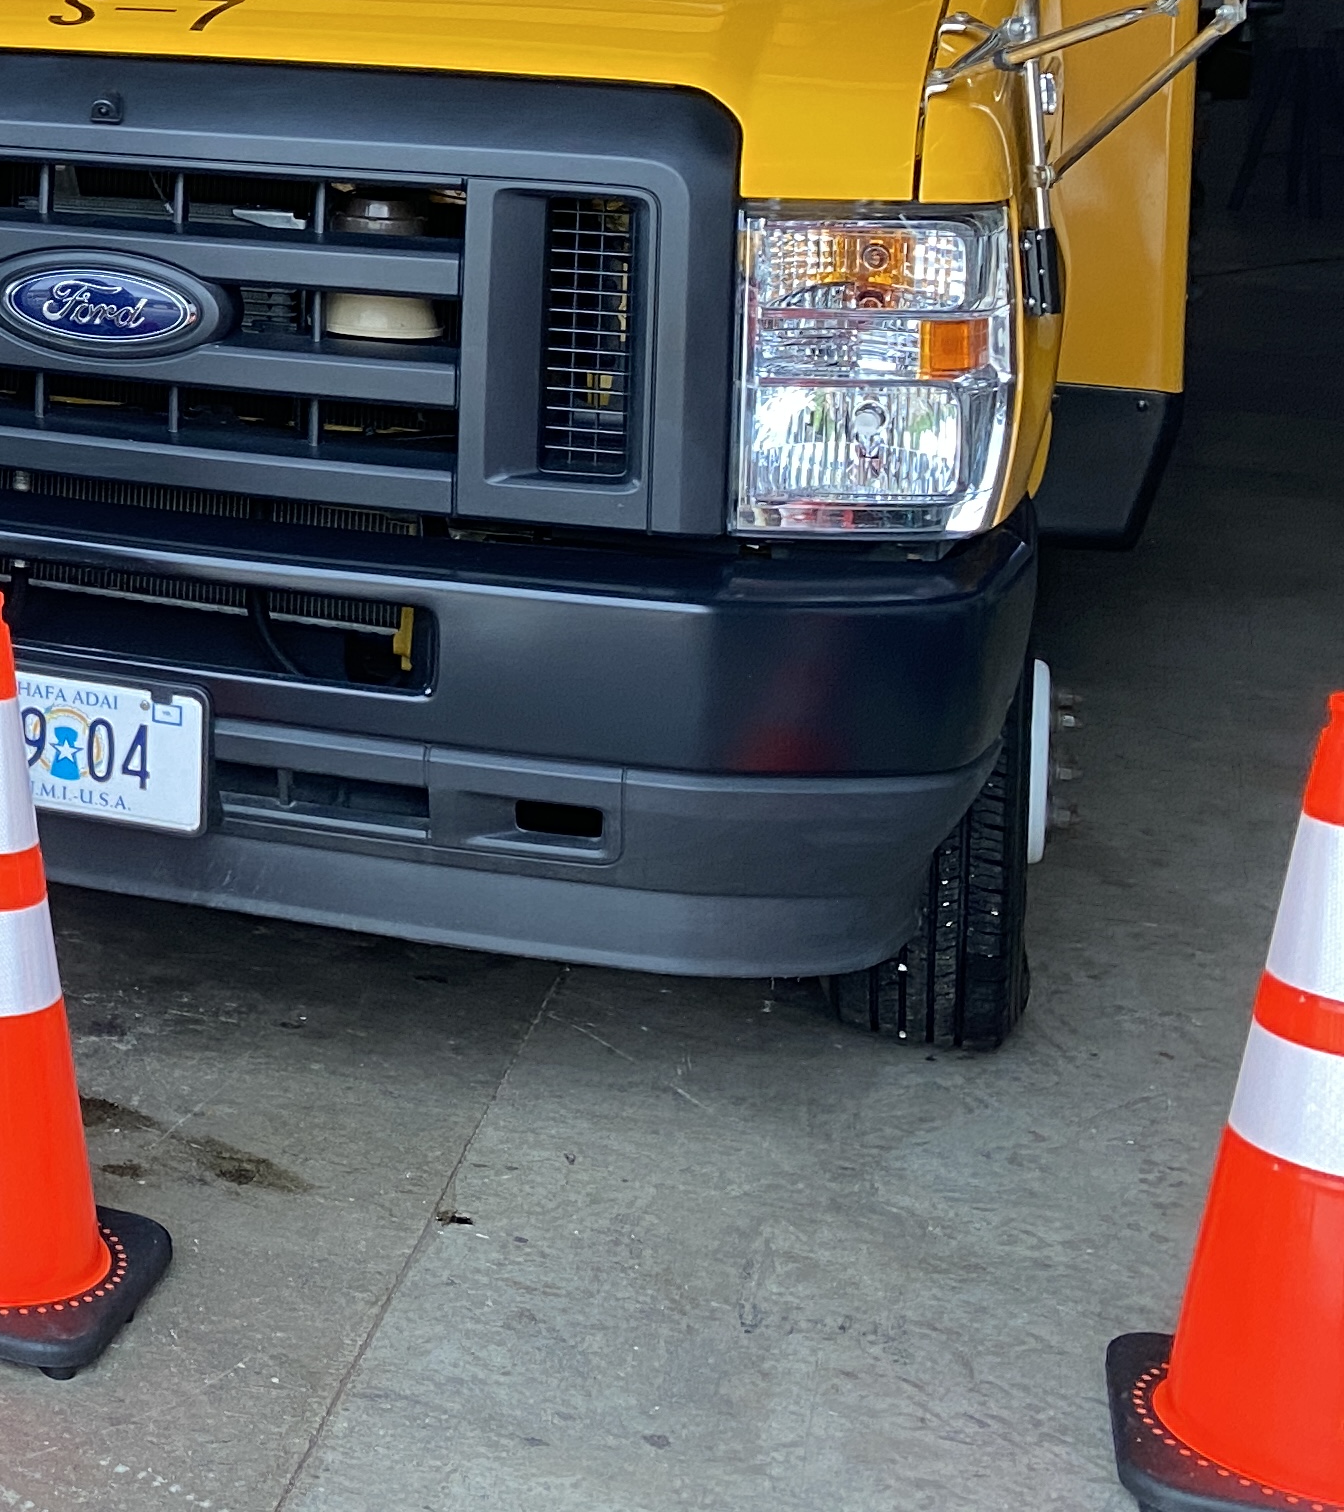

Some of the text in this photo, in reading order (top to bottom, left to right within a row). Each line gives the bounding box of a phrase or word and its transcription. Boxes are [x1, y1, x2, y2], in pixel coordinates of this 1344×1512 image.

[42, 279, 149, 329] Ford
[18, 681, 119, 711] HAFA ADAI
[87, 717, 151, 791] 04
[31, 781, 132, 812] .M.I.-U.S.A.
